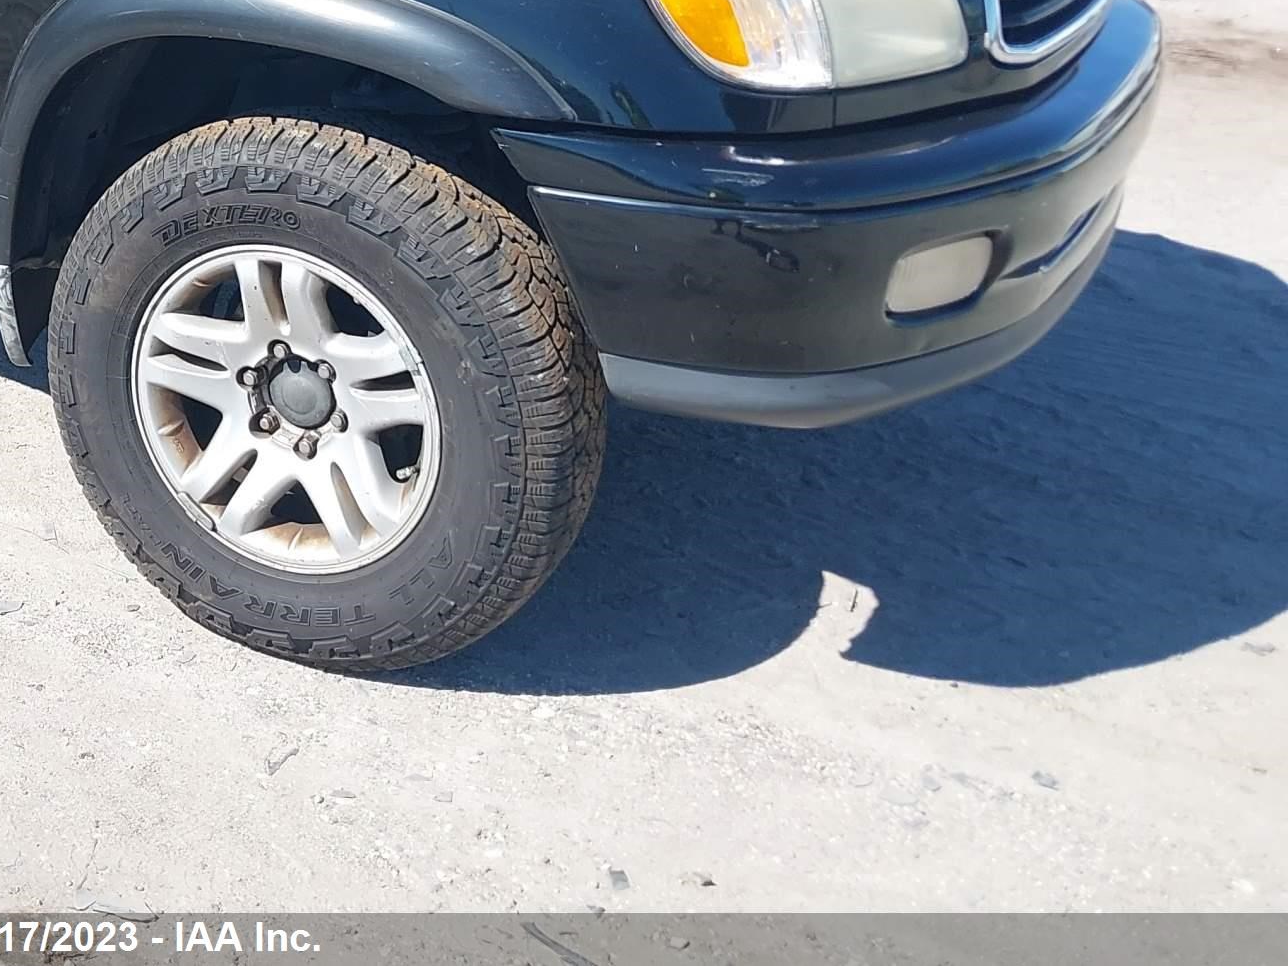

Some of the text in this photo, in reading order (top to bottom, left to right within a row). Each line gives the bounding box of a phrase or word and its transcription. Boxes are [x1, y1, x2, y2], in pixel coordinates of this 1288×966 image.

[151, 203, 301, 248] DEXTERO
[162, 529, 454, 627] ALL TERRAIN
